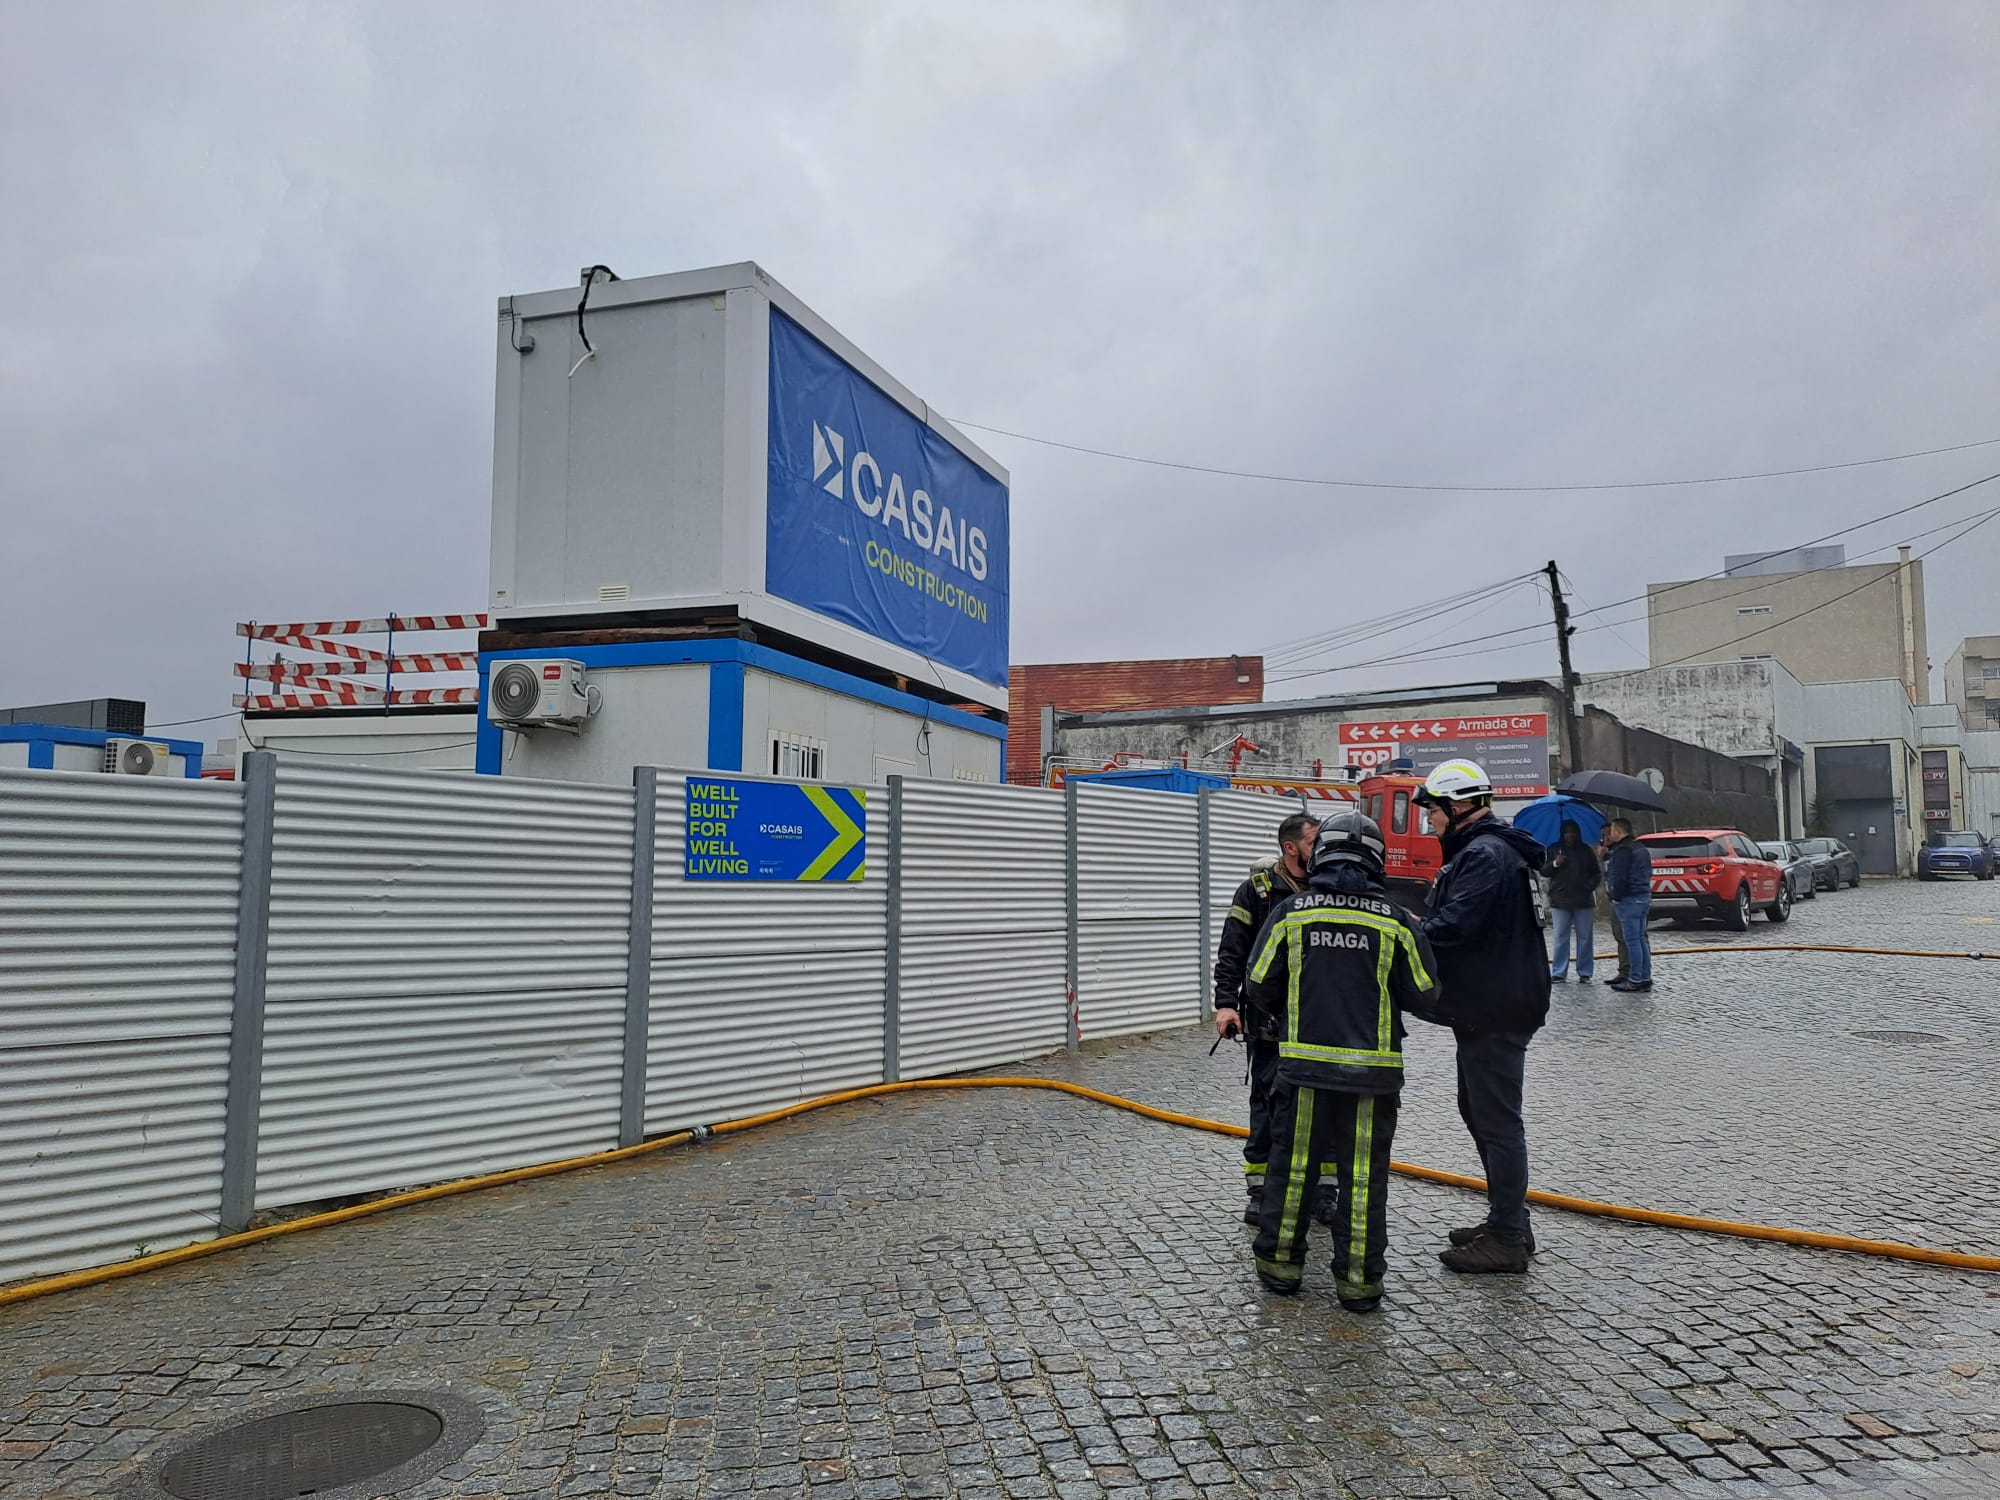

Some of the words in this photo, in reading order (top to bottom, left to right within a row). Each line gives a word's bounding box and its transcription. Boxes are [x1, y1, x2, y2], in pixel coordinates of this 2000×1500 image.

[851, 451, 988, 581] CASAIS
[865, 540, 987, 624] CONSTRUCTION
[1457, 718, 1508, 731] Armada
[1511, 717, 1533, 728] Car
[1349, 750, 1391, 766] TOP
[690, 784, 740, 801] WELL
[690, 803, 738, 819] BUILT
[689, 822, 727, 837] FOR
[767, 824, 803, 835] CASAIS
[690, 840, 739, 856] WELL
[688, 859, 749, 875] LIVING
[1294, 894, 1392, 915] SAPADORES
[1309, 931, 1370, 951] BRAGA
